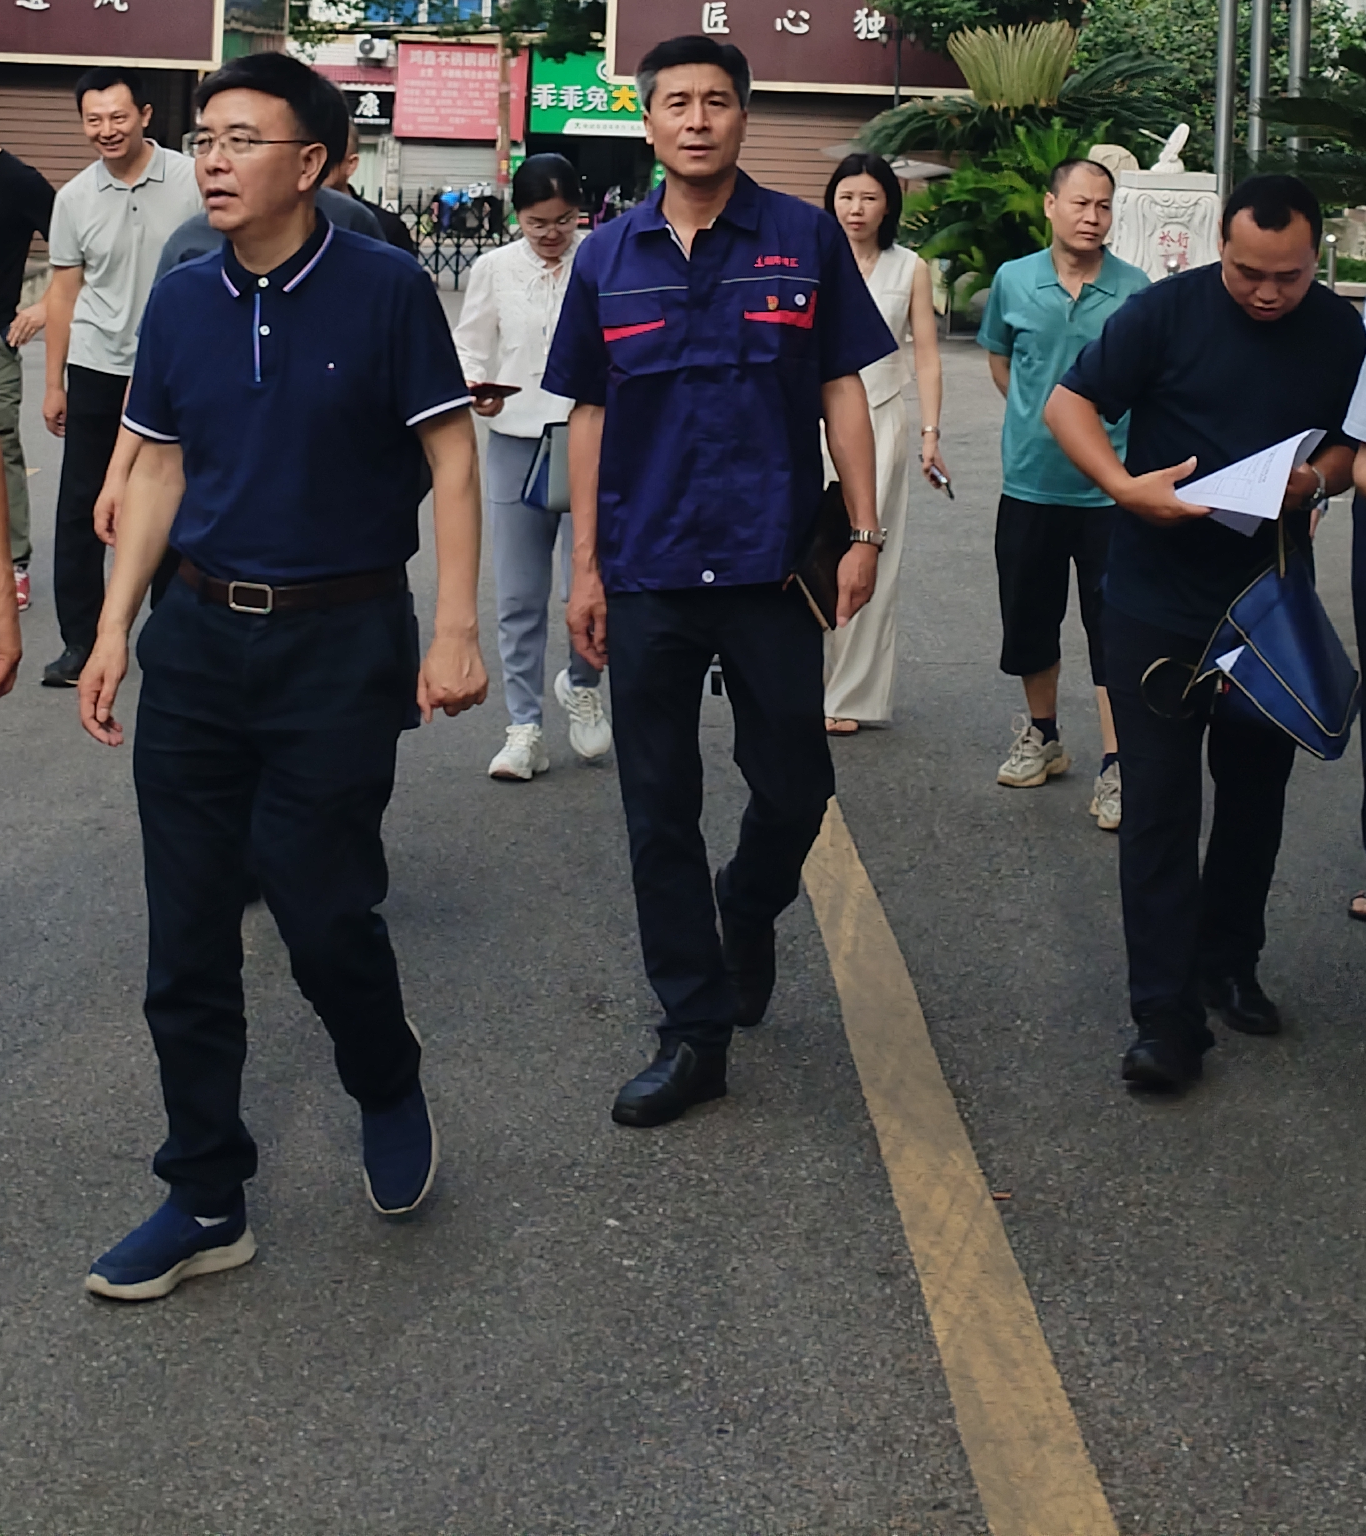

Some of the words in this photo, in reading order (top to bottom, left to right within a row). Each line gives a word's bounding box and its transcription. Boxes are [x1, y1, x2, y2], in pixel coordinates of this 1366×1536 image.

[701, 2, 886, 40] 匠心独
[531, 83, 645, 112] 乖乖兔大
